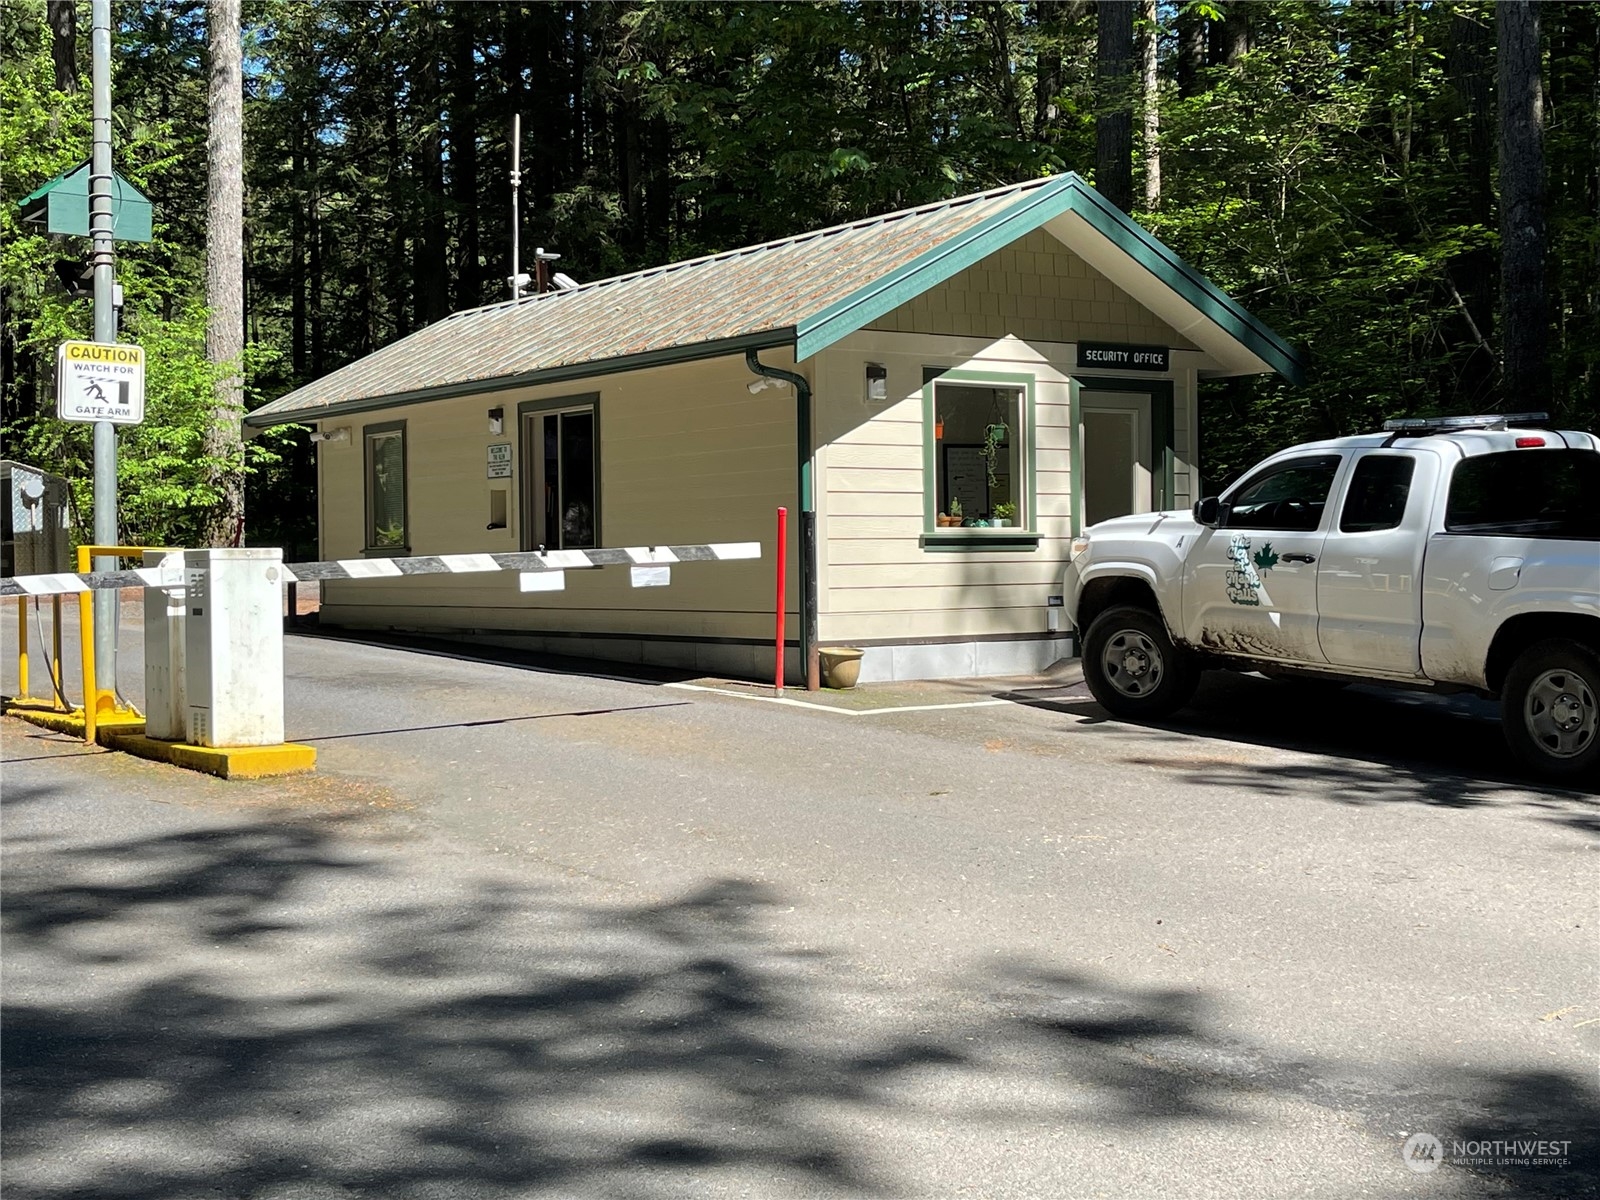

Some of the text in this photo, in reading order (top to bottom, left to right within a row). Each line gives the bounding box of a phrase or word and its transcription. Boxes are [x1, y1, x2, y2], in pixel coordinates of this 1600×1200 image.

[70, 346, 138, 362] CAUTION
[1086, 350, 1164, 365] SECURITY OFFICE
[74, 363, 134, 374] WATCH FOR
[75, 405, 130, 416] GATE ARM
[1226, 570, 1260, 589] Maple
[1226, 587, 1259, 605] Falls
